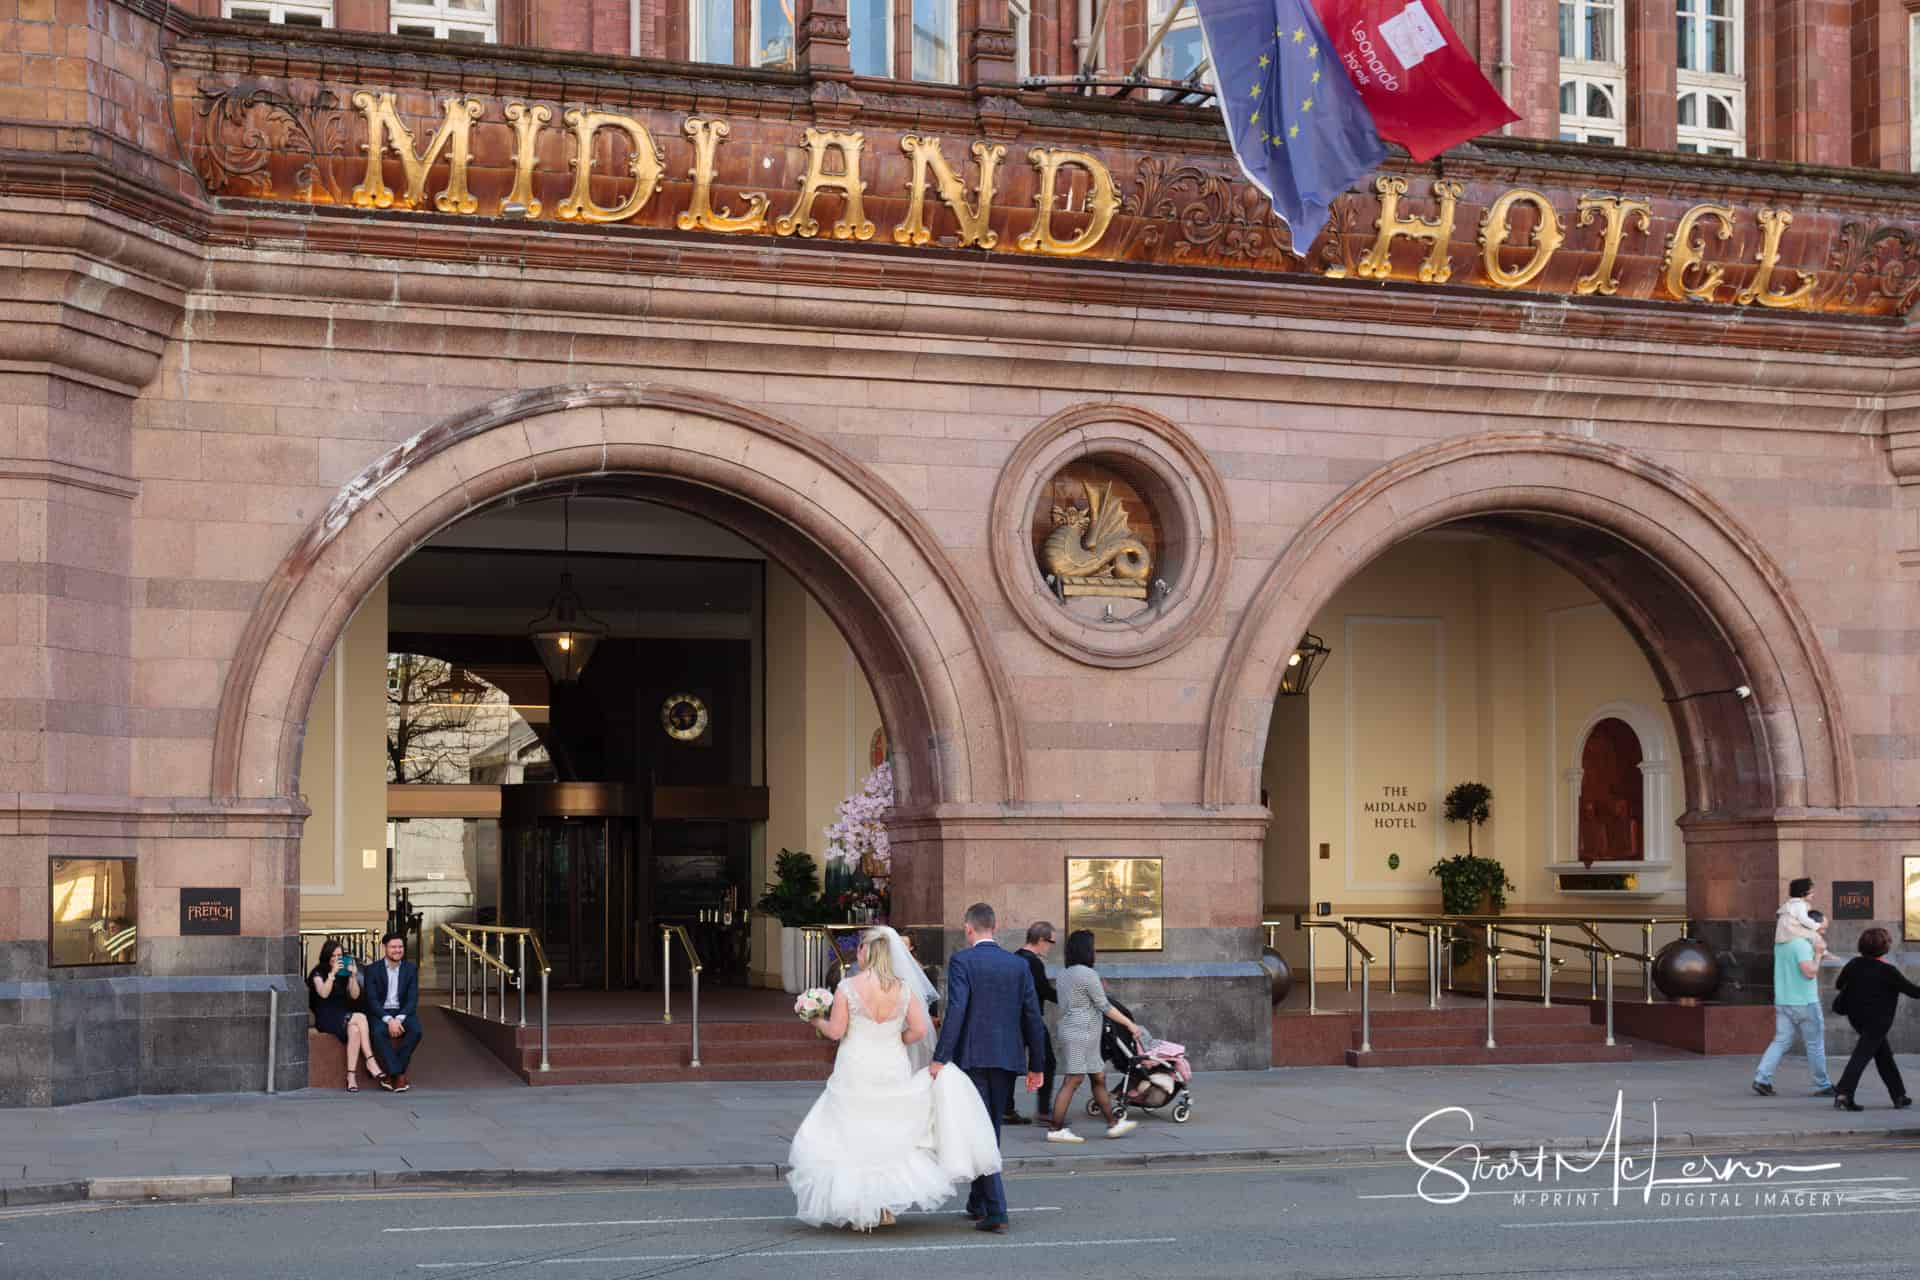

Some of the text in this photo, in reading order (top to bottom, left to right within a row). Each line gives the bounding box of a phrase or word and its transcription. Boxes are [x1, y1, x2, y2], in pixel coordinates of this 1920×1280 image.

[1351, 20, 1399, 91] Leonardo
[351, 90, 1817, 308] MIDLAND HOTEL
[1383, 786, 1408, 796] THE
[1364, 802, 1427, 812] MIDLAND
[1375, 818, 1417, 828] HOTEL
